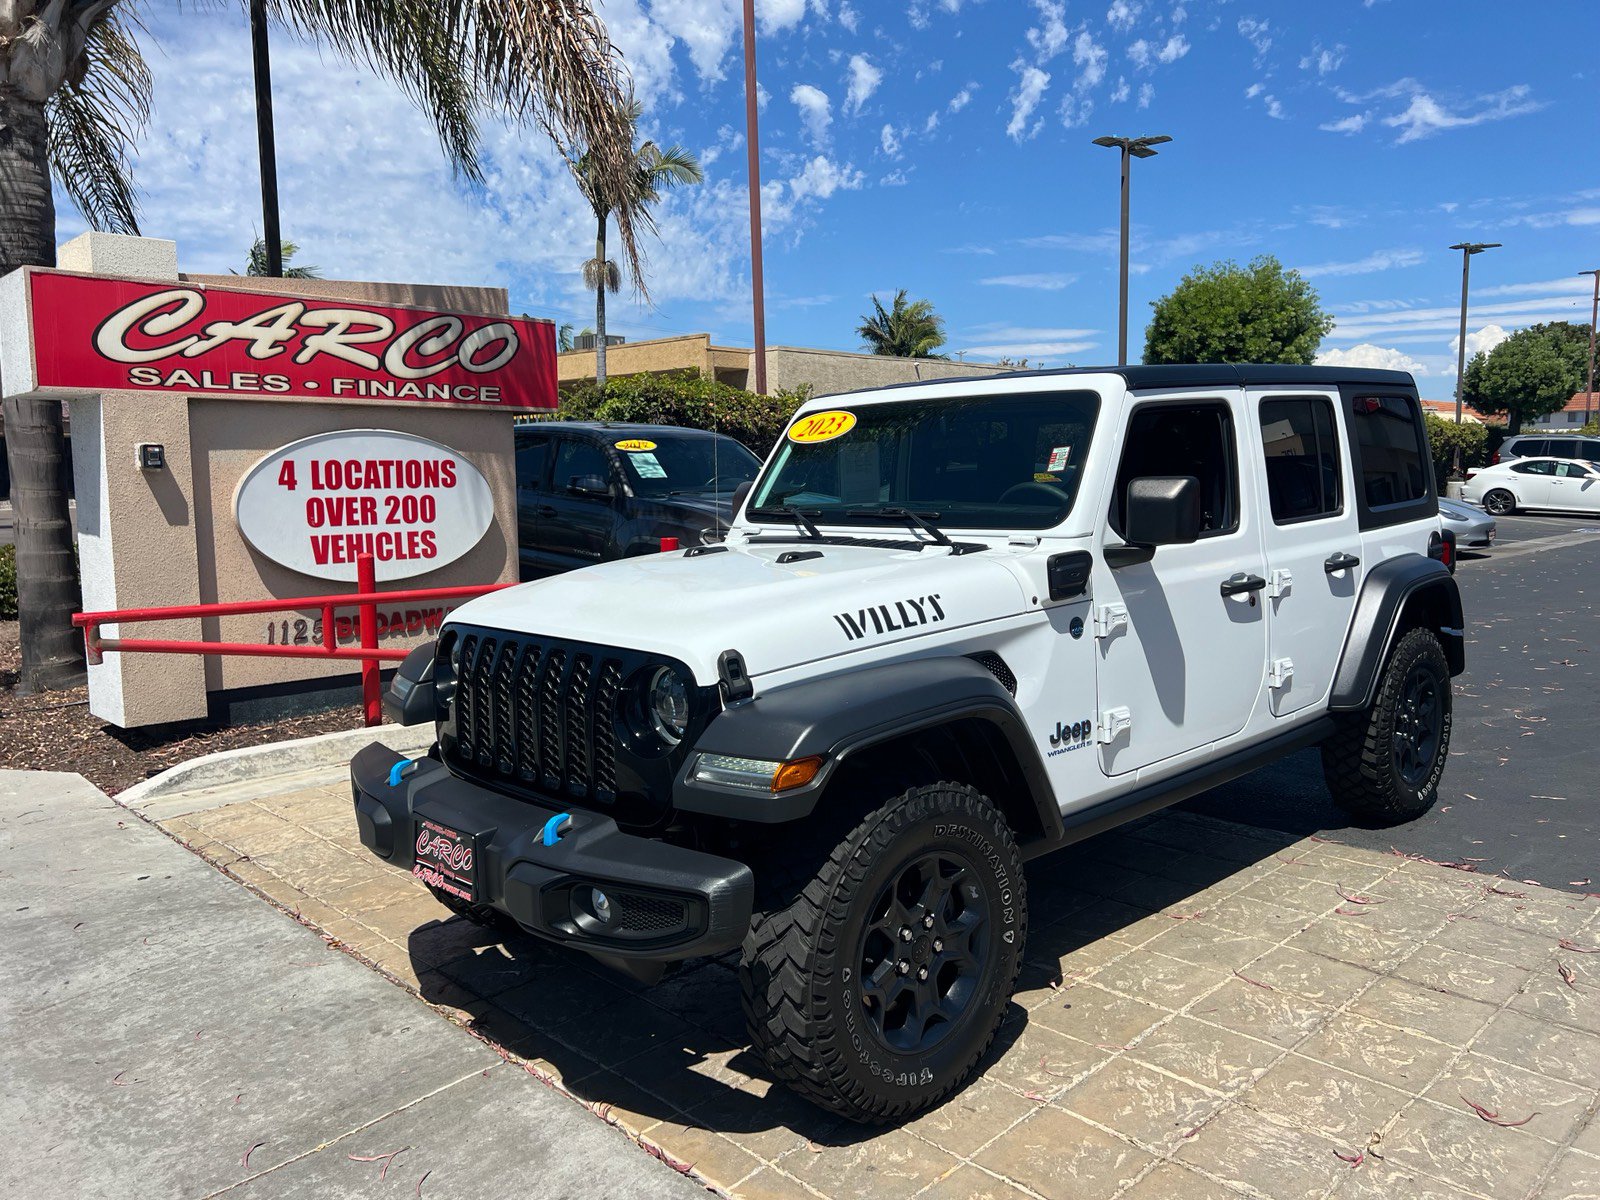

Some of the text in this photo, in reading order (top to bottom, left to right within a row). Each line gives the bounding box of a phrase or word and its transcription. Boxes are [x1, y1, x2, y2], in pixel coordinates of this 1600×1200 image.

[92, 289, 520, 380] CARCO
[128, 366, 503, 402] SALES FINANCE
[796, 415, 847, 437] 2023
[278, 459, 457, 491] 4 LOCATIONS
[306, 494, 436, 528] OVER 200
[310, 530, 437, 565] VEHICLES
[832, 594, 945, 641] WILLYS
[1049, 719, 1092, 744] Jeep
[1047, 742, 1086, 757] WRANGLER
[415, 829, 473, 871] CARCO
[934, 824, 1015, 924] DESTINATION
[842, 989, 934, 1086] Firestone
